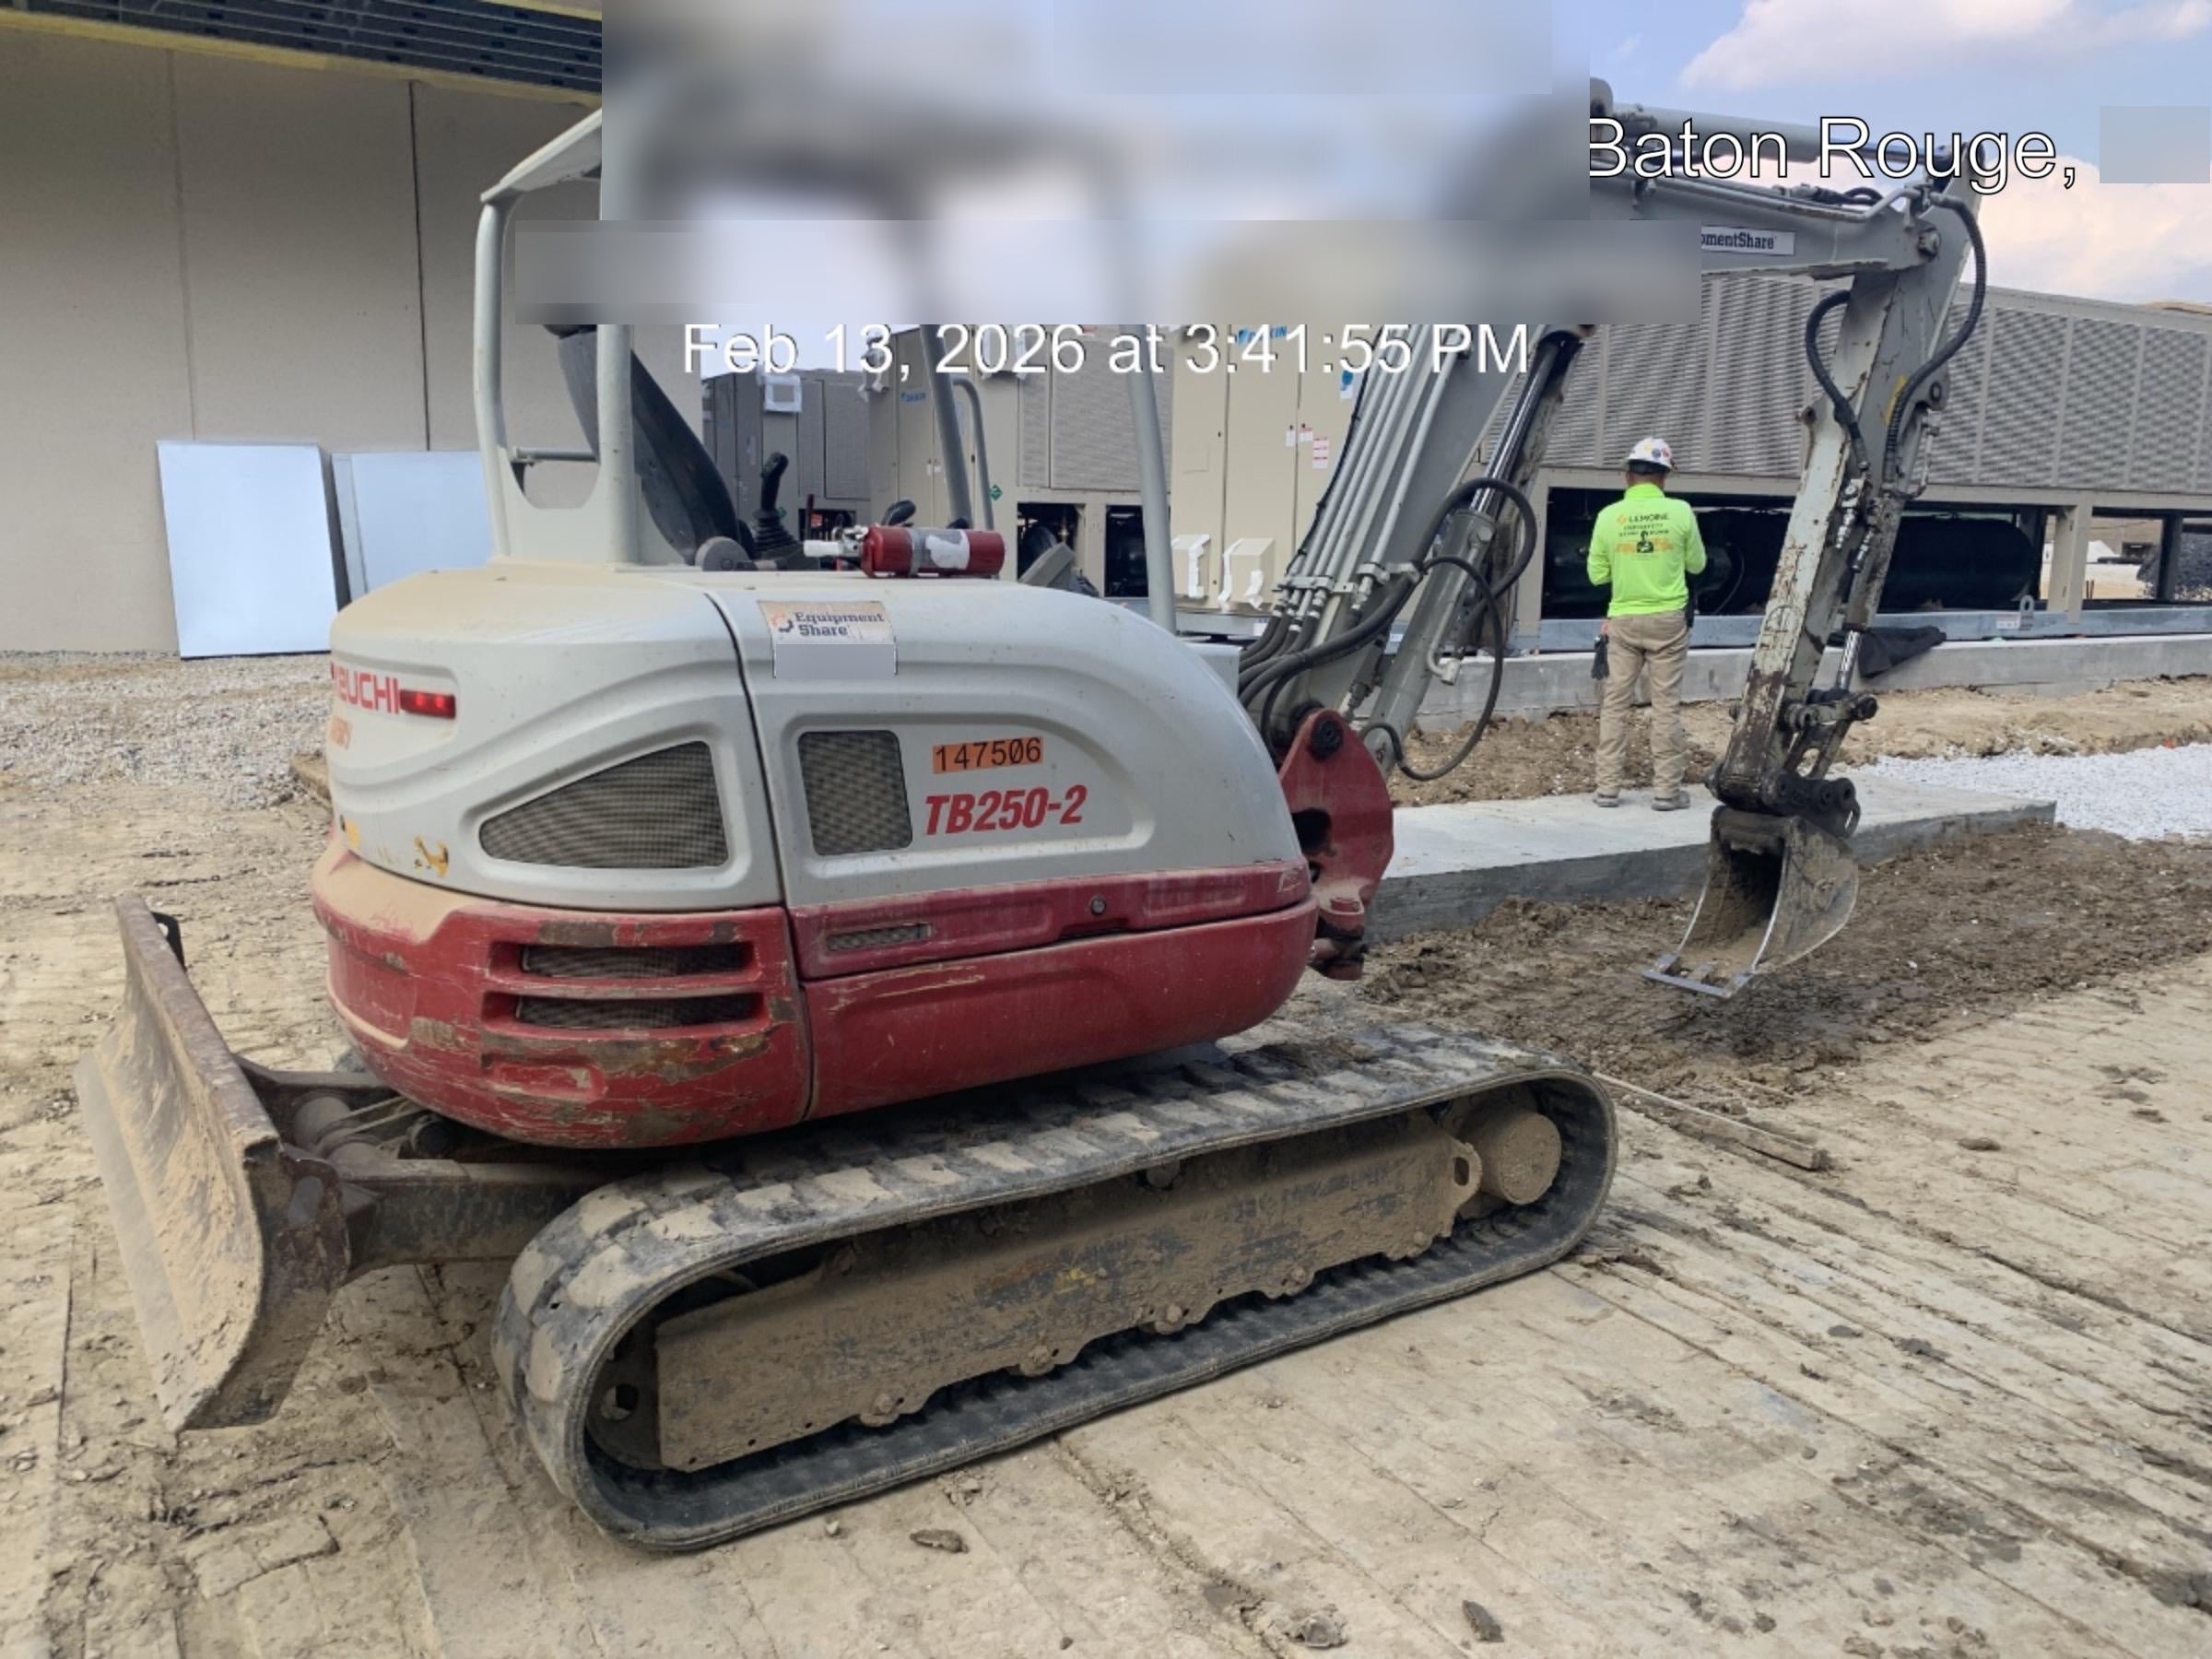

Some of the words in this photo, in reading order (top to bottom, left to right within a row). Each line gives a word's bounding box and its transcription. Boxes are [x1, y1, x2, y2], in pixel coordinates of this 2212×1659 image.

[794, 611, 885, 625] Equipment
[797, 624, 850, 636] Share
[330, 662, 400, 715] EUCHI
[935, 737, 1041, 772] 147506
[925, 784, 1088, 836] TB250-2
